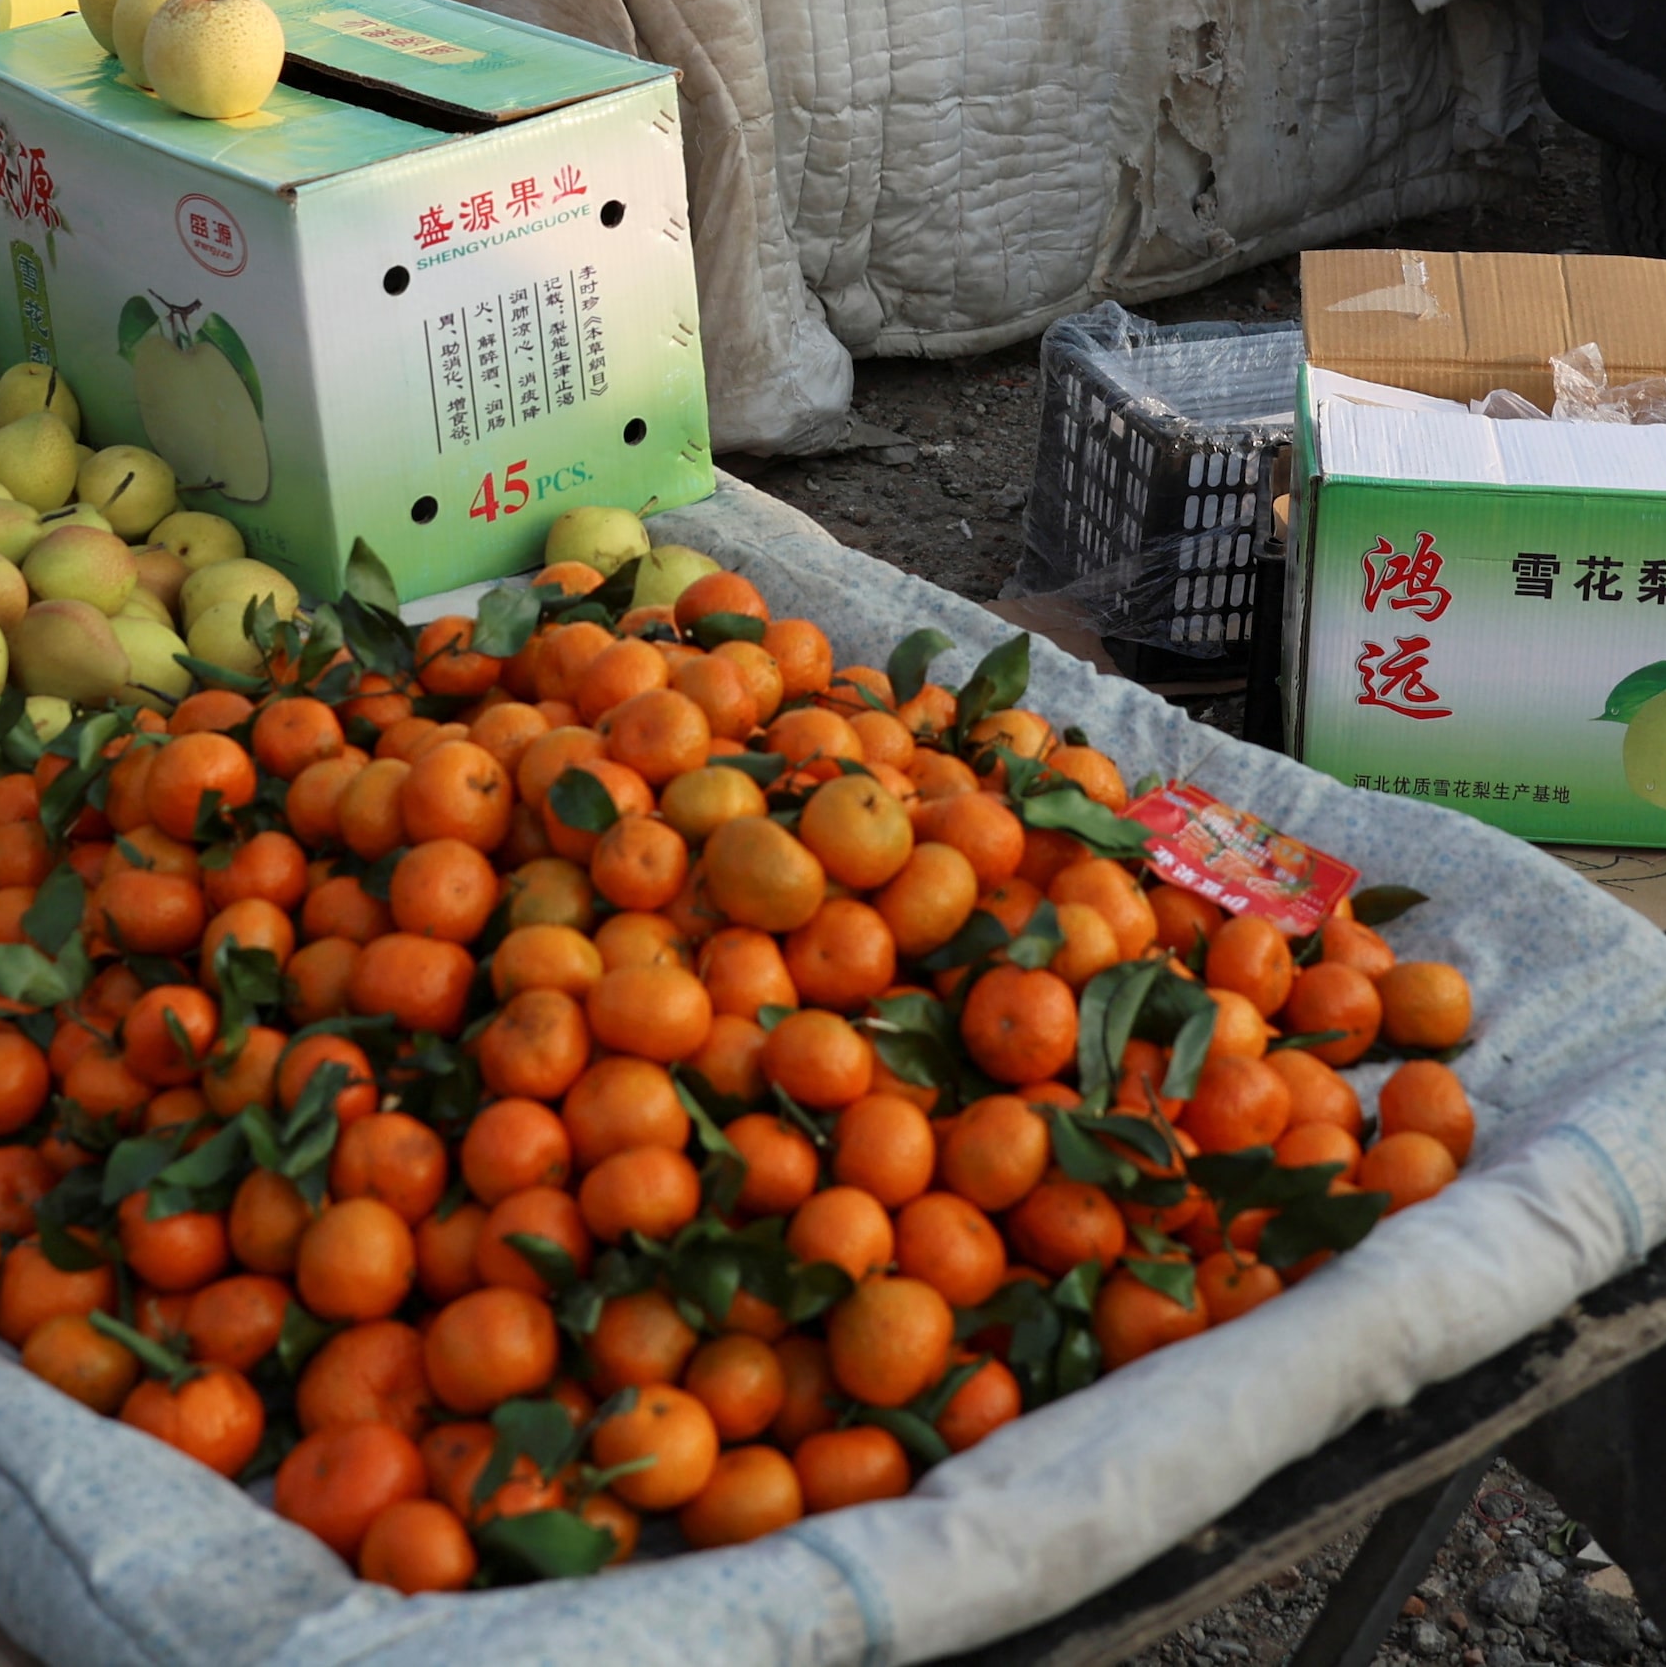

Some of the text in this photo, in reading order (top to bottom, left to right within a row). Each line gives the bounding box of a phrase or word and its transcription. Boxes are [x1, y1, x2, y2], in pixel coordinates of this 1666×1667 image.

[189, 213, 232, 248] 盛源
[413, 164, 588, 249] 盛源果业
[416, 203, 592, 271] SHENGYUANGUOYE
[469, 459, 594, 523] 45 PCS.
[1356, 529, 1454, 721] 鸿远
[1353, 774, 1570, 804] 河北优质雪花梨生产基地
